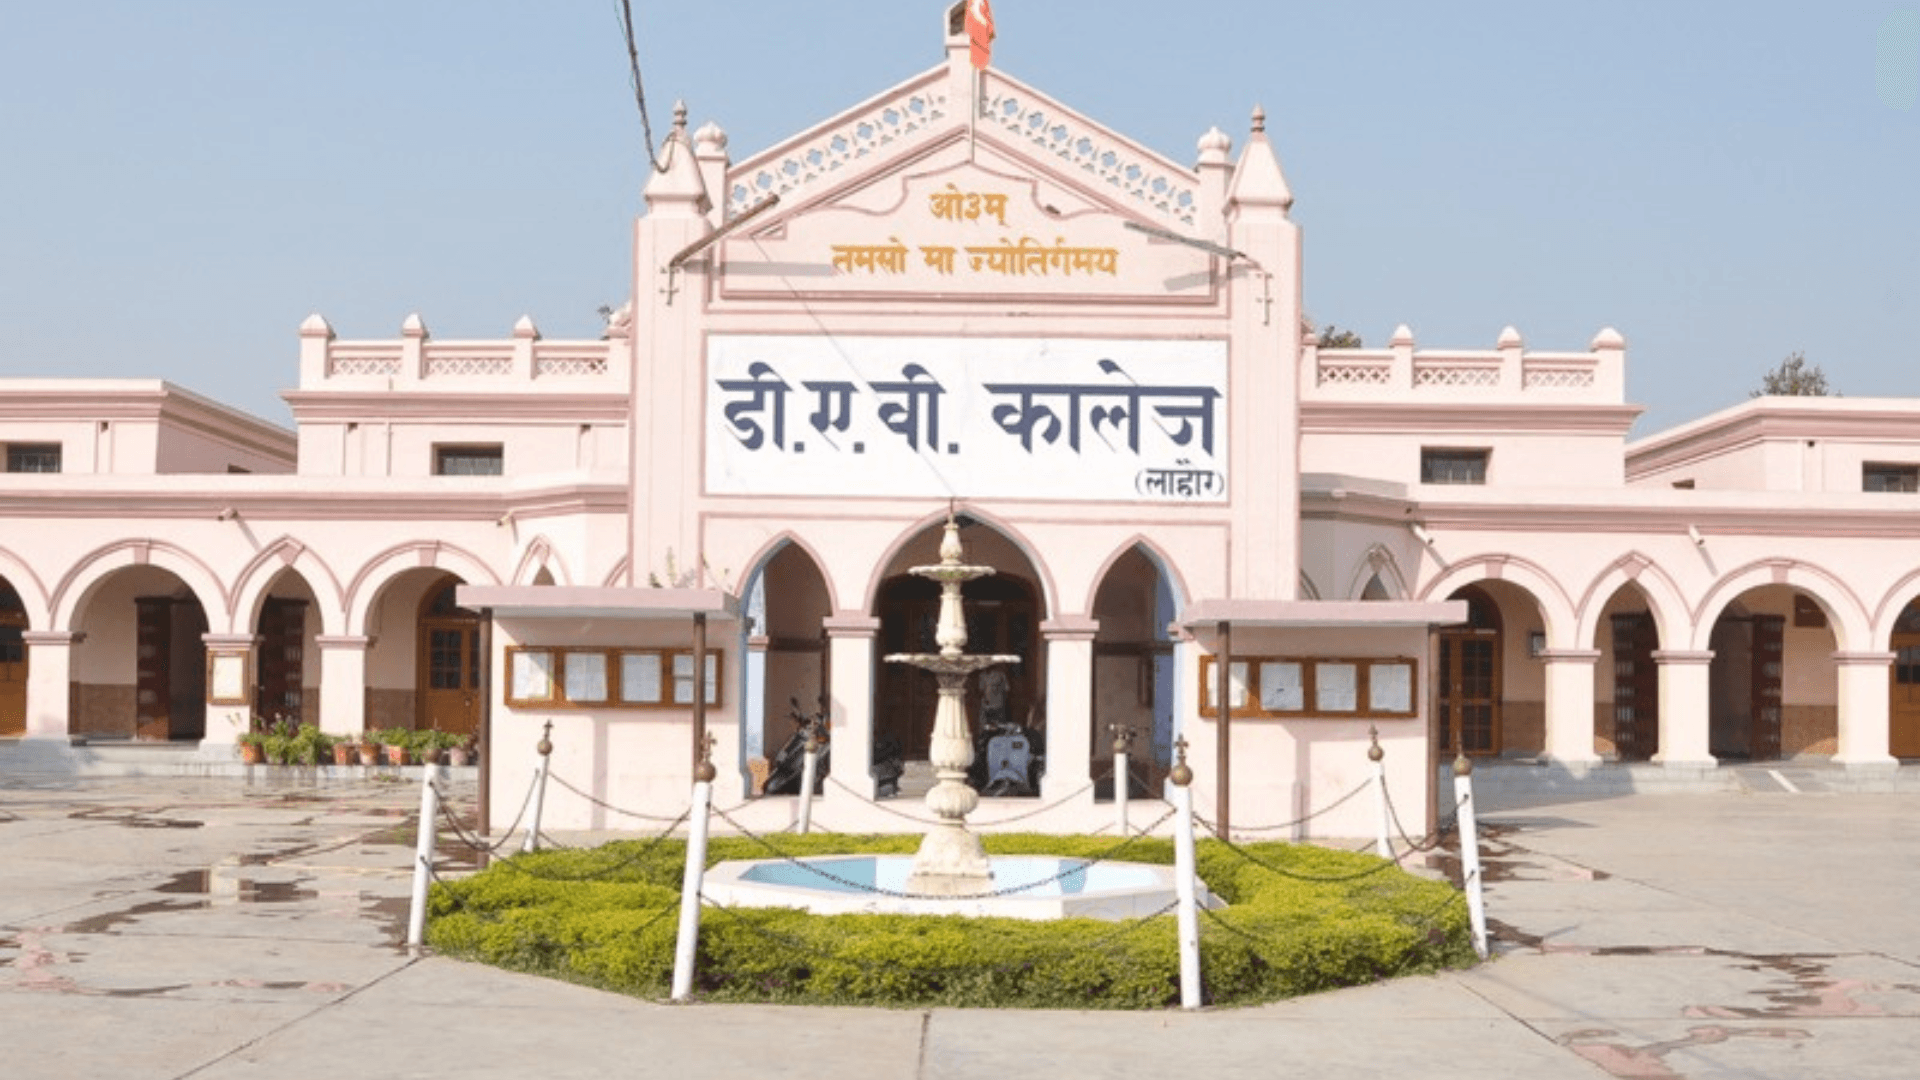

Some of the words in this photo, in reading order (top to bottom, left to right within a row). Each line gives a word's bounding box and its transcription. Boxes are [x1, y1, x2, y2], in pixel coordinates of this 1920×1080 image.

[830, 236, 909, 275] तमसो
[918, 244, 957, 275] मा
[963, 236, 1119, 277] ज्योतिर्गमय
[715, 361, 960, 454] डी.ए.वी.
[982, 358, 1224, 457] कालेज
